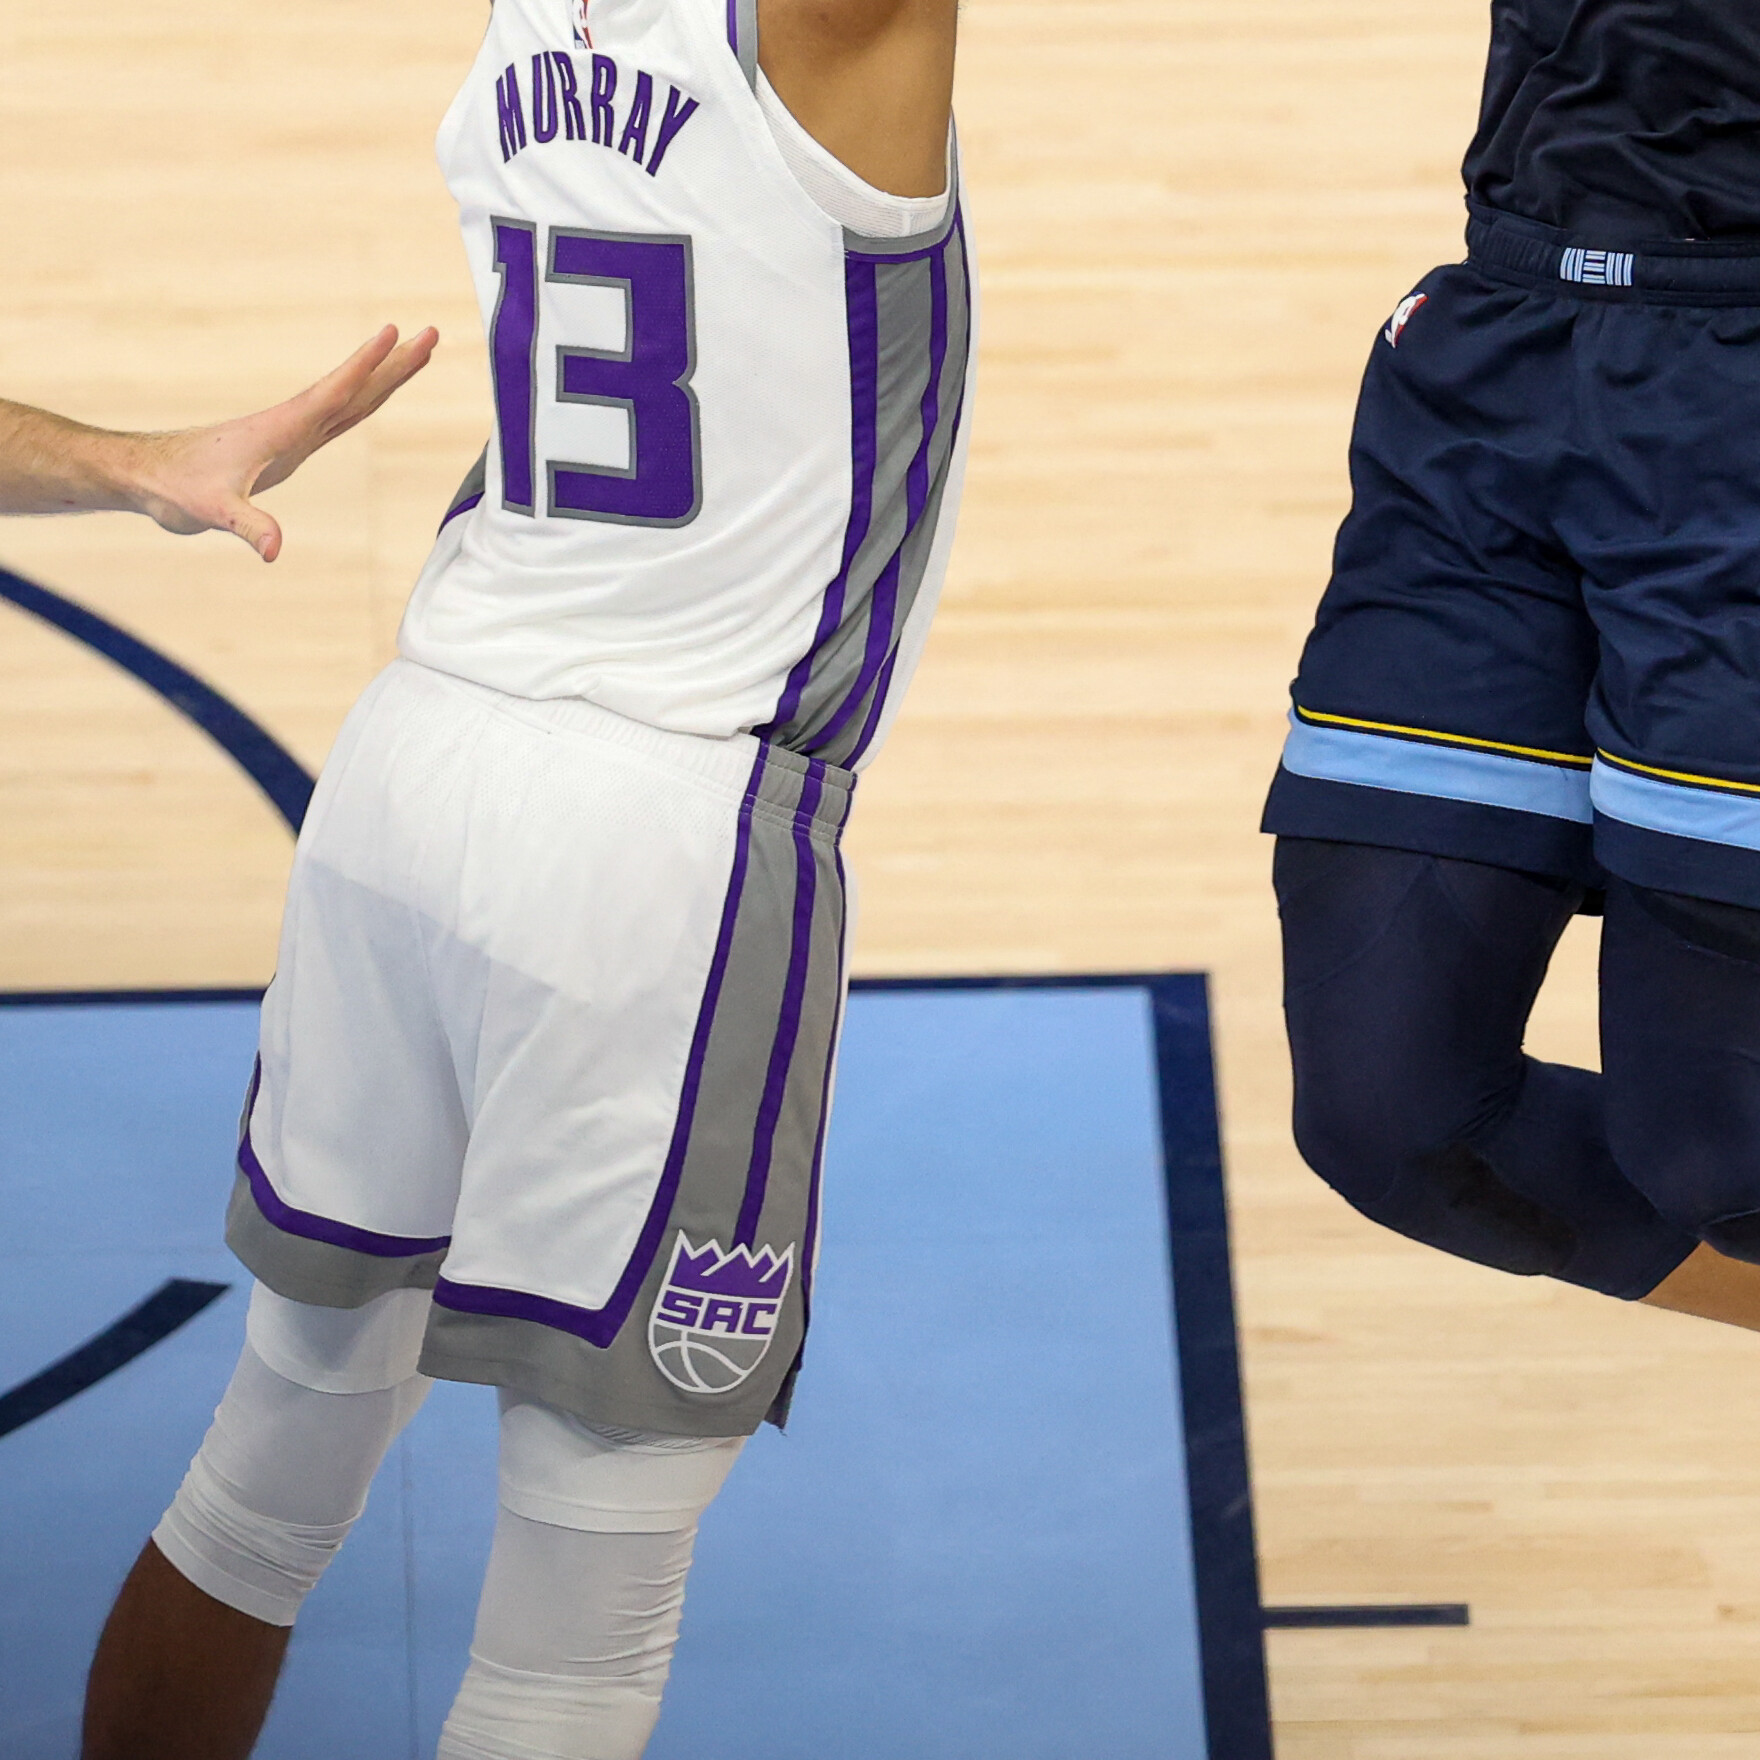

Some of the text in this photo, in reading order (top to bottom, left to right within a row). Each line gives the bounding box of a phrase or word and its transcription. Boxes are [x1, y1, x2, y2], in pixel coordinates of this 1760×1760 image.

[495, 50, 701, 178] MURRAY
[490, 214, 703, 530] 13
[656, 1289, 778, 1335] SAC
